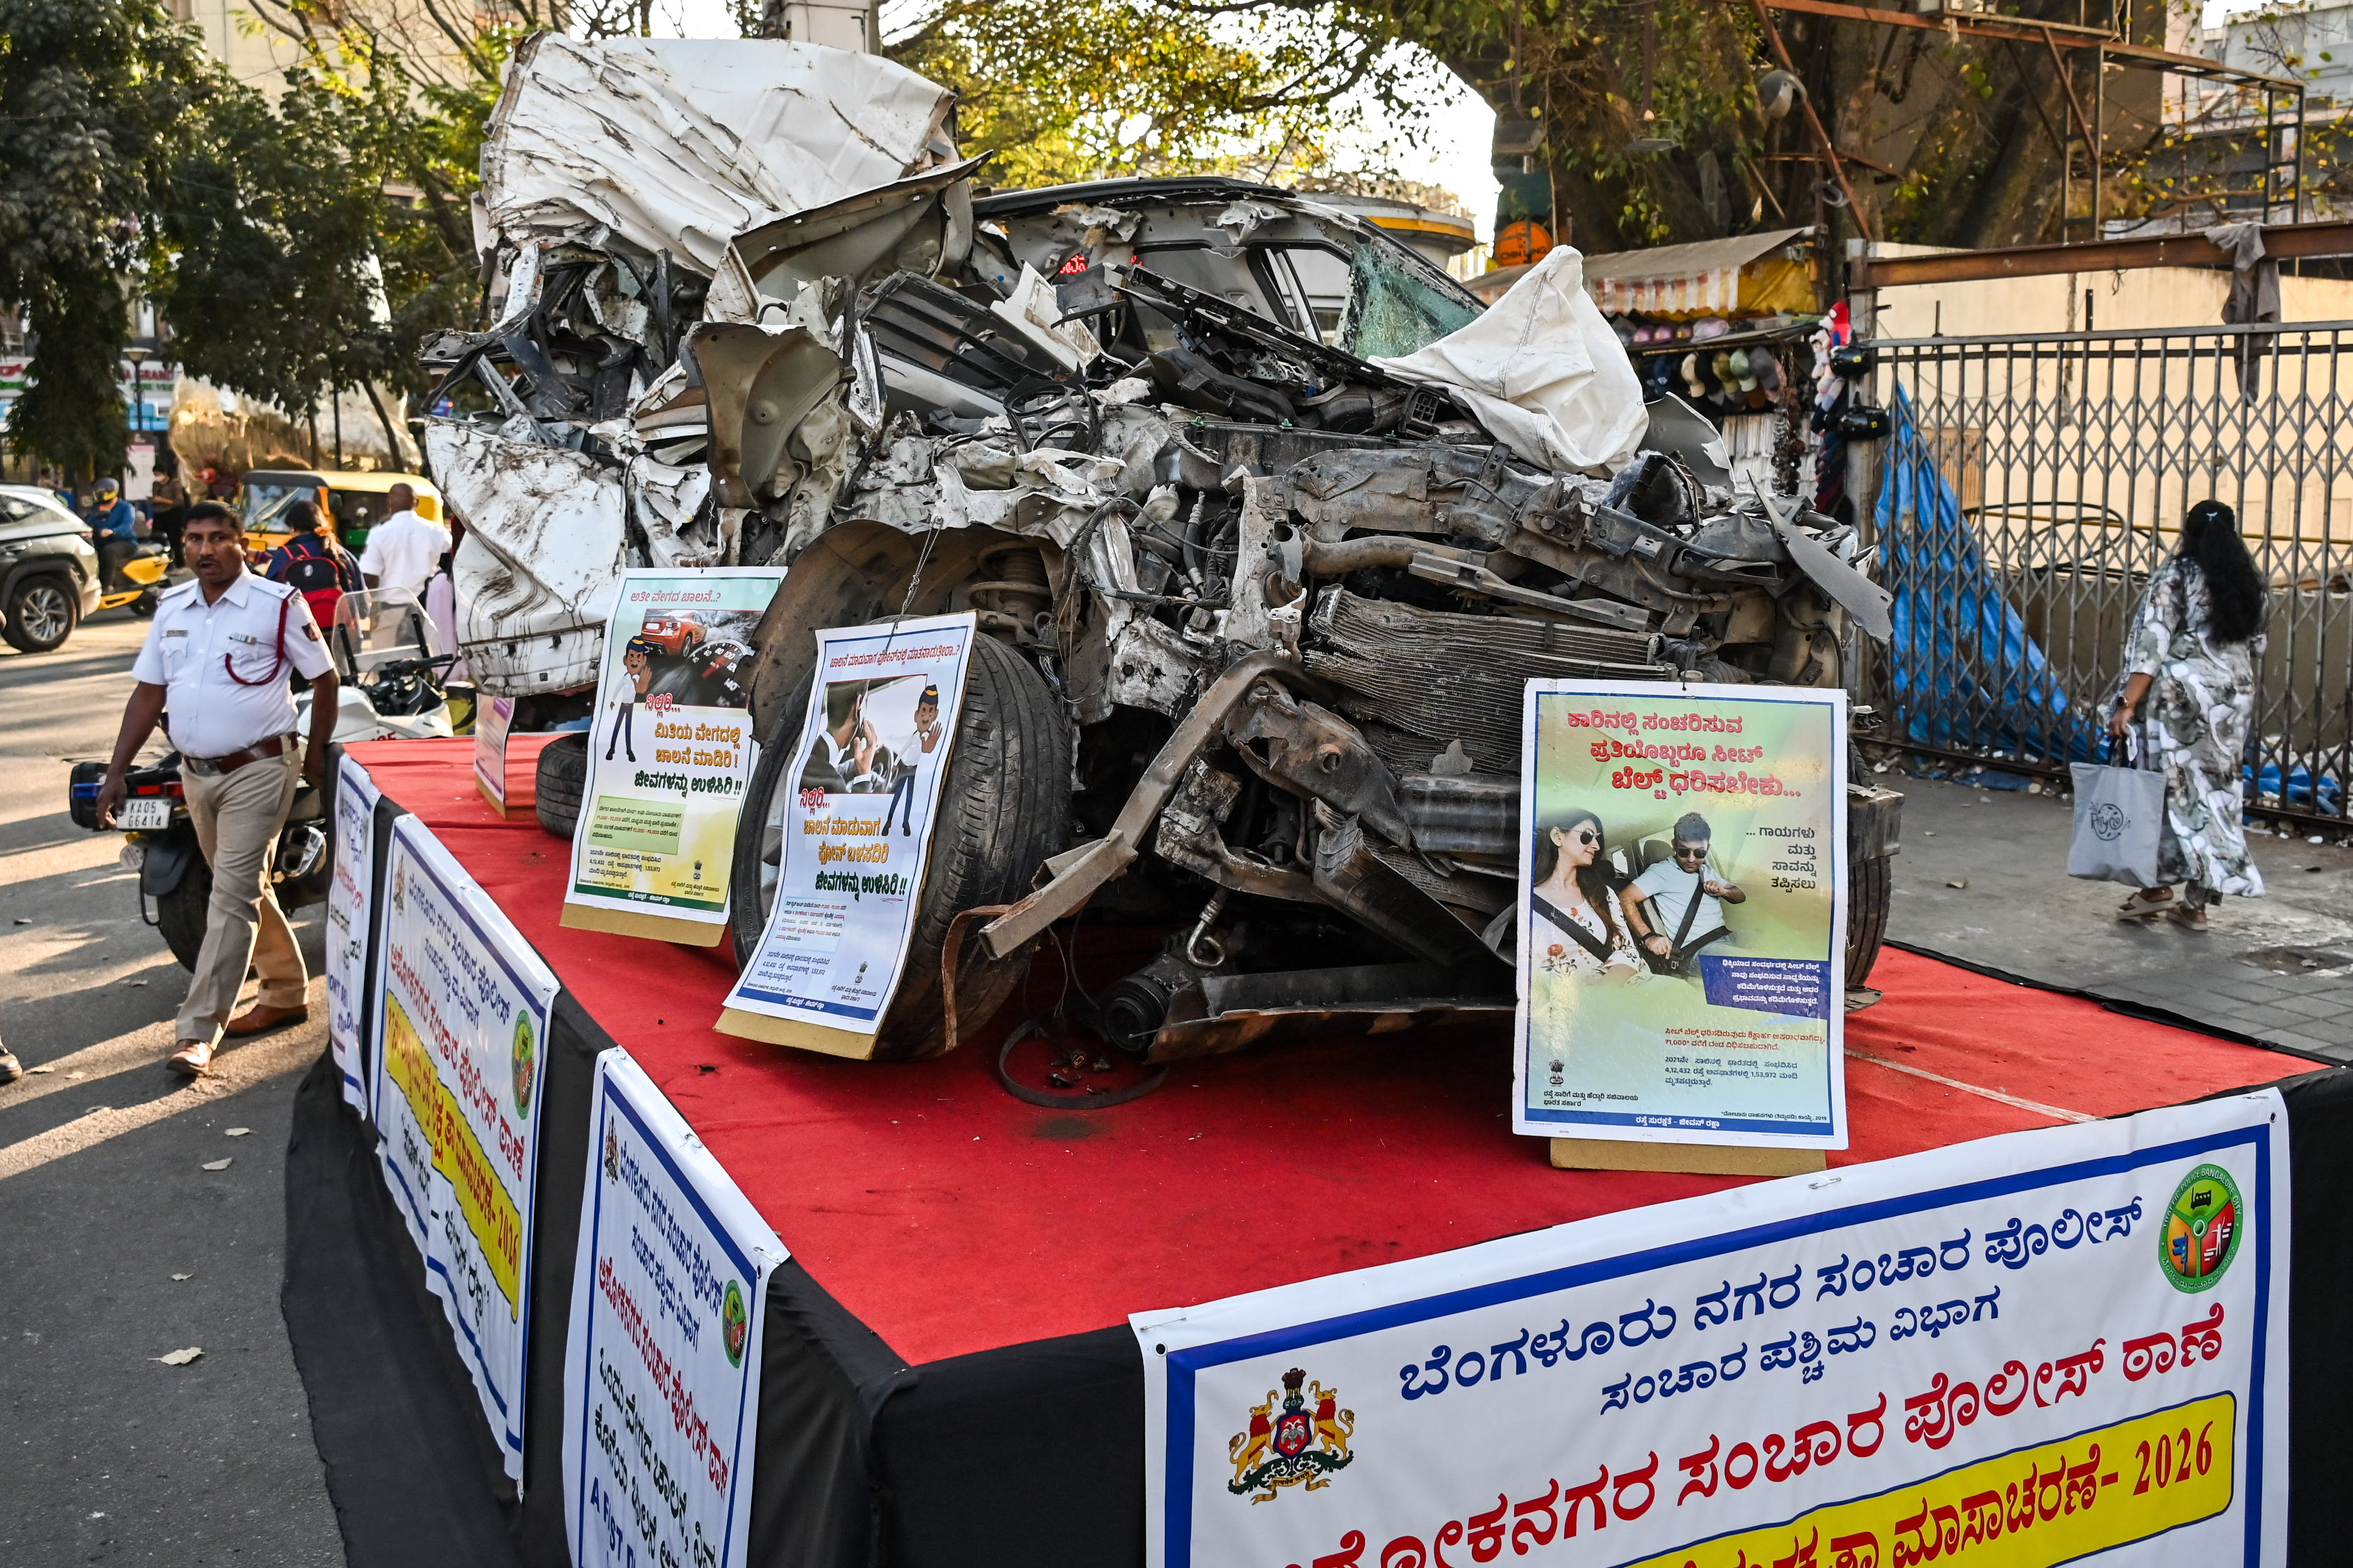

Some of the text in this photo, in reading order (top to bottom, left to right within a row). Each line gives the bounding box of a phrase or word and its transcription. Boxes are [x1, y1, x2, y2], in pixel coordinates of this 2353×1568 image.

[651, 590, 680, 602] ವೇಗದ
[655, 723, 740, 749] ಮಿತಿಯ ವೇಗದಲ್ಲಿ
[1568, 710, 1743, 736] ಕಾರಿನಲ್ಲಿ ಸಂಚರಿಸುವ
[656, 747, 691, 764] ಚಾಲನೆ
[694, 749, 732, 767] ಮಾಡಿರಿ
[1590, 739, 1763, 767] ಪ್ರತಿಯೊಬ್ಬರೂ ಸೀಟ್
[635, 770, 687, 798] ಜೀವಗಳನ್ನು
[691, 776, 732, 794] ಉಳಿಸಿರಿ
[1611, 766, 1666, 799] ಬೆಲ್ಟ್
[131, 802, 156, 813] KA05
[804, 815, 881, 836] ಚಾಲನೆ ಮಾಡುವಾಗ
[1759, 827, 1815, 838] ಗಾಯಗಳು
[847, 843, 889, 864] ಬಳಸದಿರಿ
[1788, 843, 1816, 860] ಮತ್ತು
[1773, 861, 1817, 877] ಸಾವನ್ನು
[815, 870, 860, 902] ಜೀವಗಳನ್ನು
[862, 872, 899, 896] ಉಳಿಸಿರಿ
[1771, 877, 1816, 893] ತಪ್ಪಿಸಲು
[451, 931, 478, 983] ಸಂಚಾರ
[1751, 961, 1787, 970] ಸಂದರ್ಭದಲ್ಲಿ
[1749, 972, 1782, 981] ಸಂಭವಿಸುವ
[1787, 986, 1801, 994] ಮತ್ತು
[1728, 1059, 1759, 1069] ಭಾರತದಲ್ಲಿ
[2201, 1167, 2235, 1195] BANGALORE
[2232, 1195, 2242, 1216] CITY
[498, 1206, 519, 1276] 2026
[621, 1140, 723, 1317] ಬೆಂಗಳೂರು ನಗರ ಸಂಚಾರ ಪೊಲೀಸ್
[632, 1222, 655, 1279] ಸಂಚಾರ
[676, 1291, 701, 1353] ವಿಭಾಗ
[1399, 1195, 2143, 1401] ಬೆಂಗಳೂರು ನಗರ ಸಂಚಾರ ಪೊಲೀಸ್
[599, 1256, 642, 1349] ಅಶೋಕನಗರ
[641, 1320, 671, 1400] ಸಂಚಾರ
[671, 1370, 709, 1462] ಪೊಲೀಸ್
[1600, 1285, 2002, 1416] ಸಂಚಾರ ಪಶ್ಚಿಮ ವಿಭಾಗ
[599, 1347, 623, 1414] ಒಂದು
[626, 1394, 653, 1472] ವೇಗದ
[1677, 1393, 1886, 1506] ಸಂಚಾರ
[1904, 1338, 2106, 1449] ಪೊಲೀಸ್
[2122, 1302, 2225, 1382] ಠಾಣೆ
[2132, 1420, 2213, 1496] 2026
[591, 1477, 600, 1513] A
